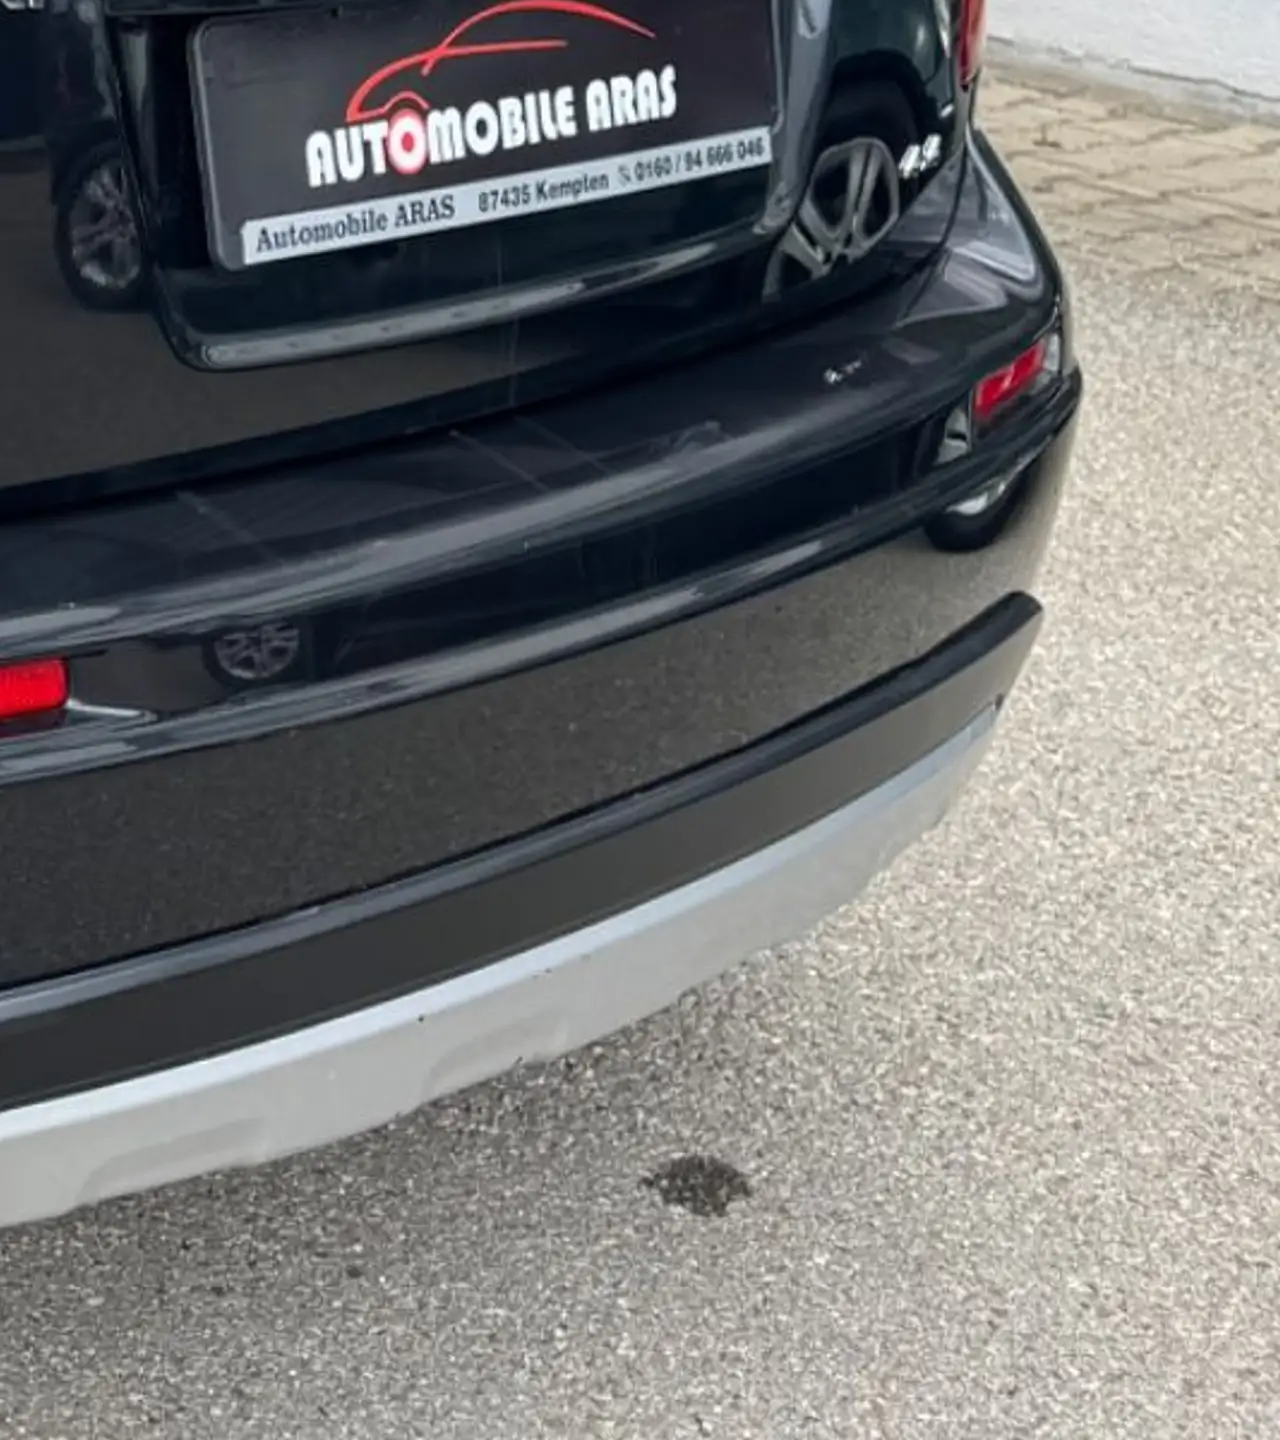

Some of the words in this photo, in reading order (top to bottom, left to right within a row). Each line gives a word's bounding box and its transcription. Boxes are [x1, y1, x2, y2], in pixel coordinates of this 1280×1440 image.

[305, 85, 578, 188] AUTOMOBILE
[585, 64, 678, 133] ARAS
[255, 207, 389, 254] Automobile
[394, 194, 456, 228] ARAS
[535, 171, 610, 202] Kempten
